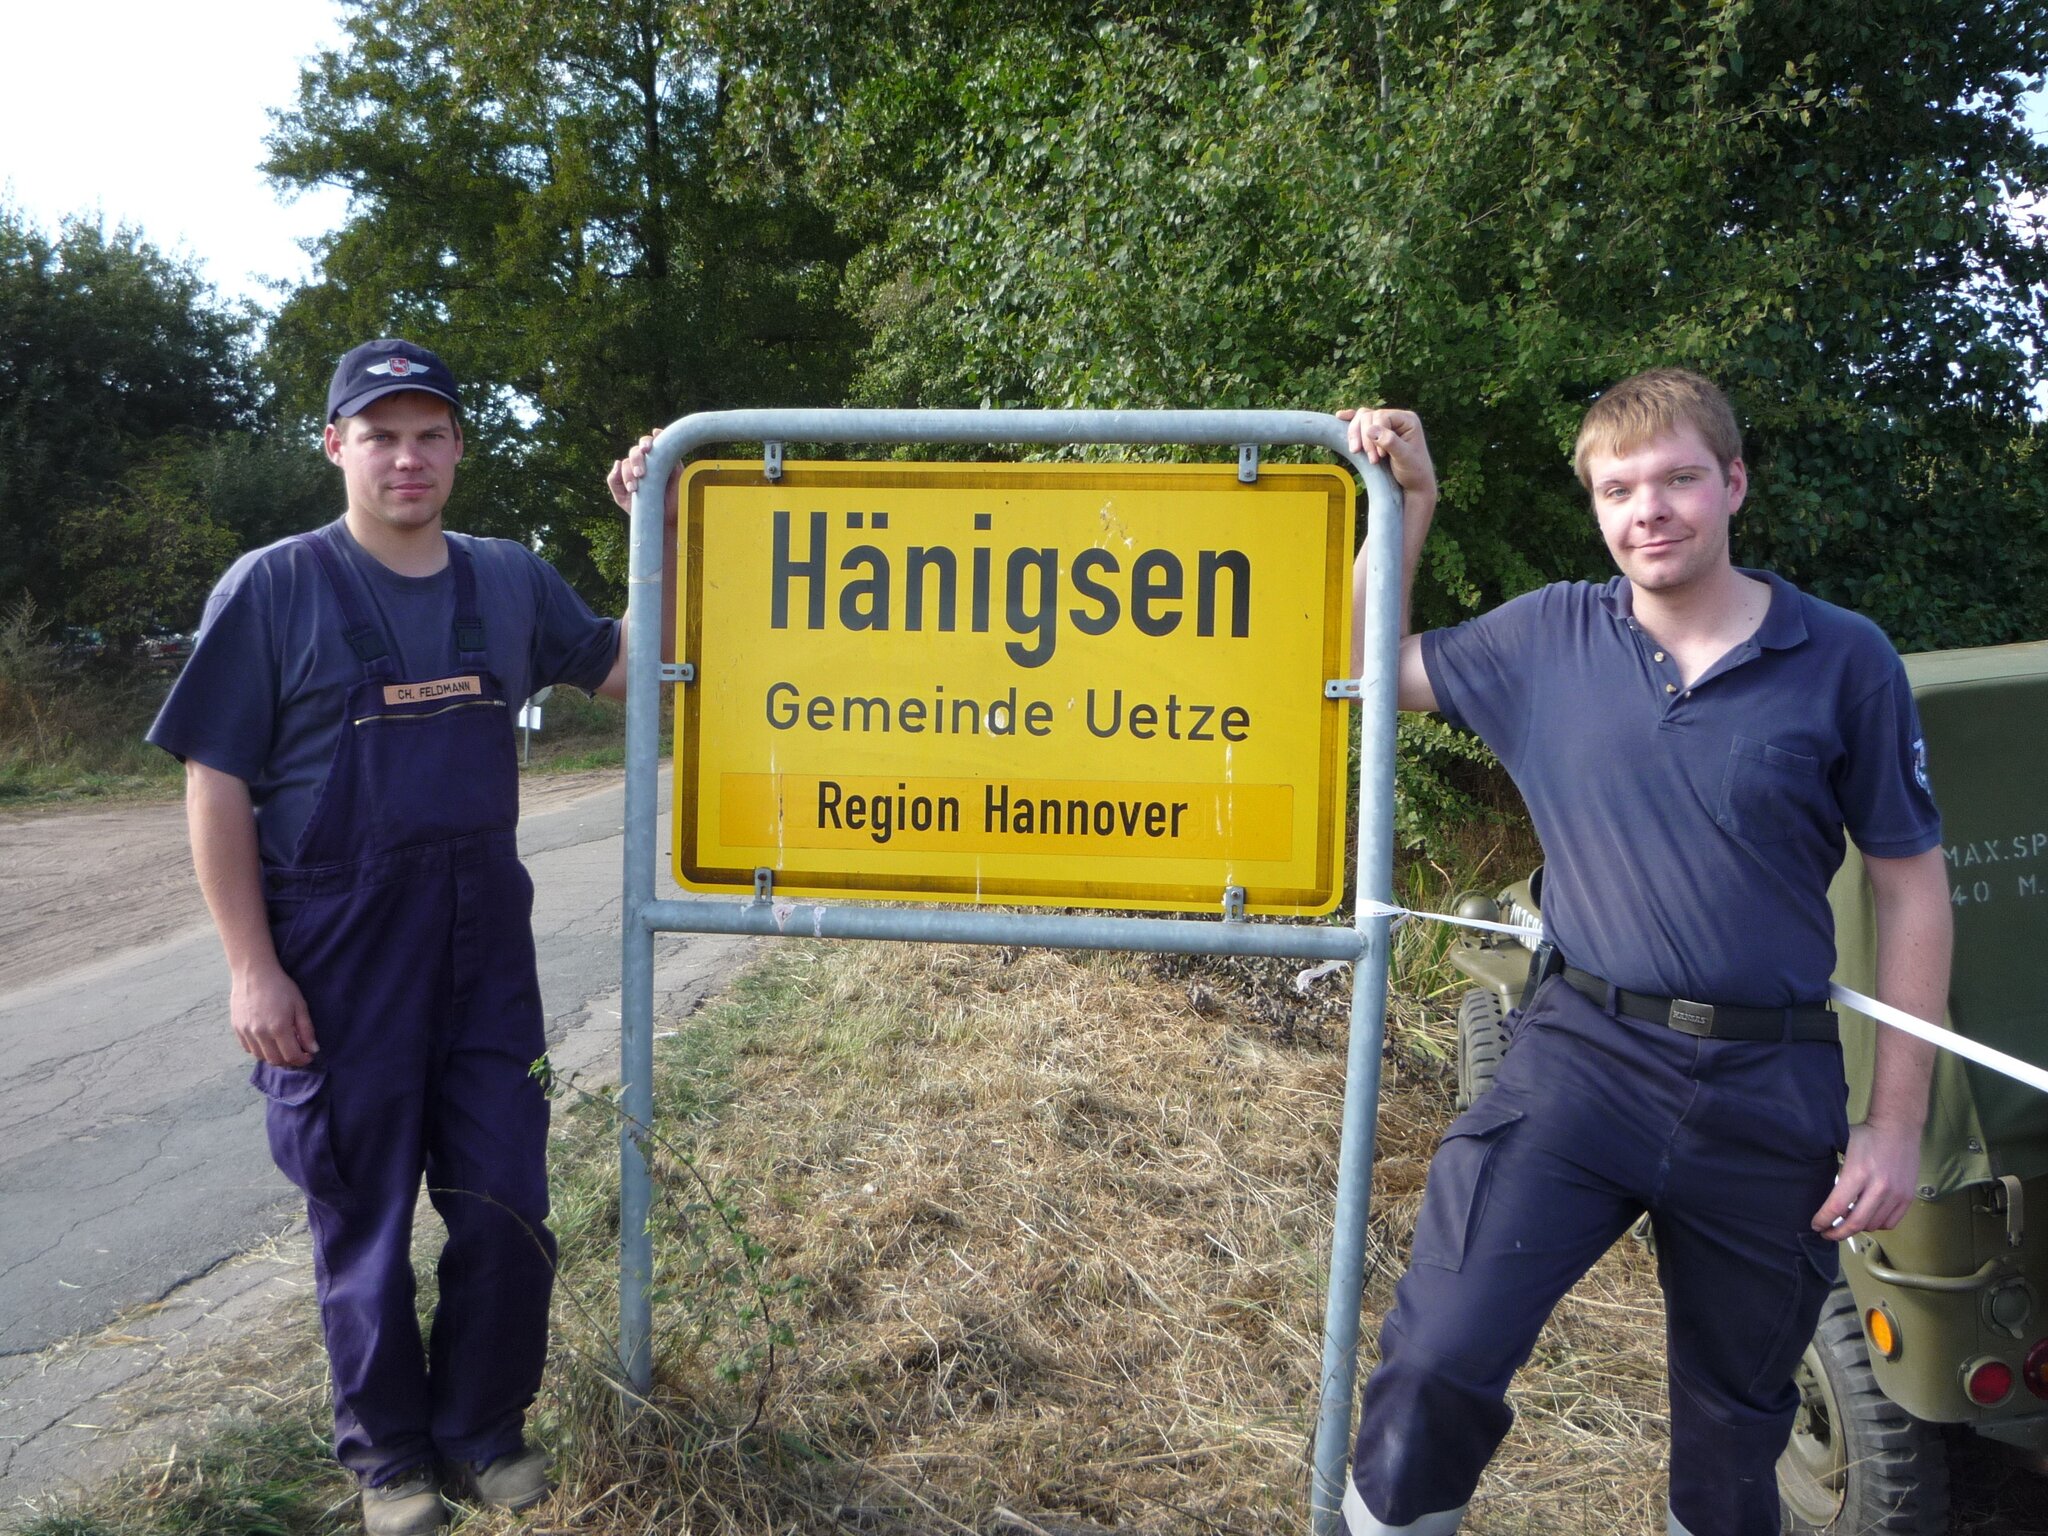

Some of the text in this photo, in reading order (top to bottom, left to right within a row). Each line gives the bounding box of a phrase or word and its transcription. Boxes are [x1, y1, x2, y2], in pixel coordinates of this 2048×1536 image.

[770, 511, 1251, 668] Hänigsen
[398, 682, 470, 700] CH. FELDMANN
[766, 681, 1251, 742] Gemeinde Uetze
[818, 781, 1188, 844] Region Hannover
[1951, 880, 1989, 906] 40
